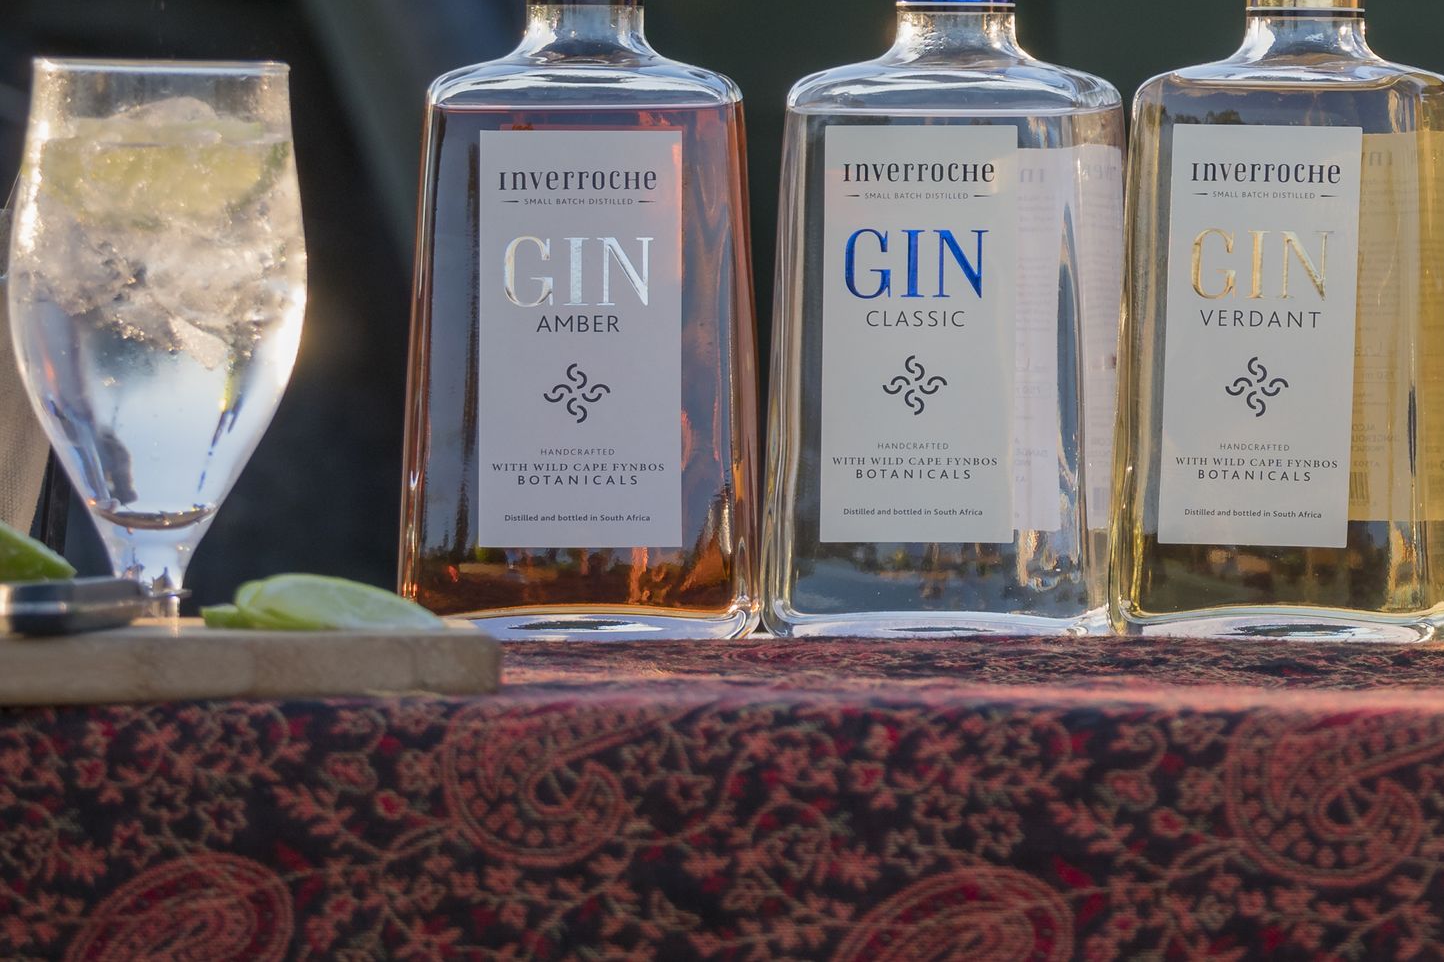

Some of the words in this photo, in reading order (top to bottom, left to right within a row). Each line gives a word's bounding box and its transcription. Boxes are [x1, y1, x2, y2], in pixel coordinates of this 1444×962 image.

[864, 191, 891, 200] SMALL
[894, 191, 922, 200] BATCH
[925, 191, 969, 200] DISTILLED
[1212, 190, 1239, 199] SMALL
[1241, 190, 1270, 199] BATCH
[1272, 190, 1316, 200] DISTILLED
[523, 197, 553, 207] SMALL
[555, 197, 585, 207] BATCH
[587, 197, 634, 206] DISTILLED
[845, 229, 988, 299] GIN
[1190, 228, 1334, 301] GIN
[504, 236, 653, 307] GIN
[535, 314, 620, 333] AMBER
[866, 310, 965, 328] CLASSIC
[1199, 309, 1322, 328] VERDANT
[540, 446, 617, 456] HANDCRAFTED
[877, 441, 950, 452] HANDCRAFTED
[1219, 442, 1290, 453] HANDCRAFTED
[491, 462, 528, 472] WITH
[533, 461, 569, 472] WILD
[572, 462, 608, 472] CAPE
[612, 461, 665, 472] FYNBOS
[832, 456, 866, 466] WITH
[870, 456, 904, 466] WILD
[908, 457, 942, 466] CAPE
[945, 457, 998, 467] FYNBOS
[1175, 456, 1208, 466] WITH
[1212, 457, 1246, 467] WILD
[1249, 457, 1283, 468] CAPE
[1286, 459, 1338, 469] FYNBOS
[855, 468, 971, 480] BOTANICALS
[1198, 469, 1312, 482] BOTANICALS
[517, 474, 638, 486] BOTANICALS
[504, 514, 539, 522] Distilled
[540, 514, 556, 522] and
[557, 513, 589, 522] bottled
[589, 514, 598, 522] in
[599, 514, 625, 523] South
[625, 514, 652, 523] Africa
[843, 507, 876, 518] Distilled
[876, 508, 892, 516] and
[892, 508, 923, 518] bottled
[923, 508, 932, 516] in
[933, 508, 958, 518] South
[958, 508, 983, 517] Africa
[1184, 508, 1216, 517] Distilled
[1216, 509, 1232, 517] and
[1232, 509, 1262, 518] bottled
[1263, 509, 1271, 518] in
[1272, 510, 1297, 518] South
[1297, 510, 1322, 519] Africa
